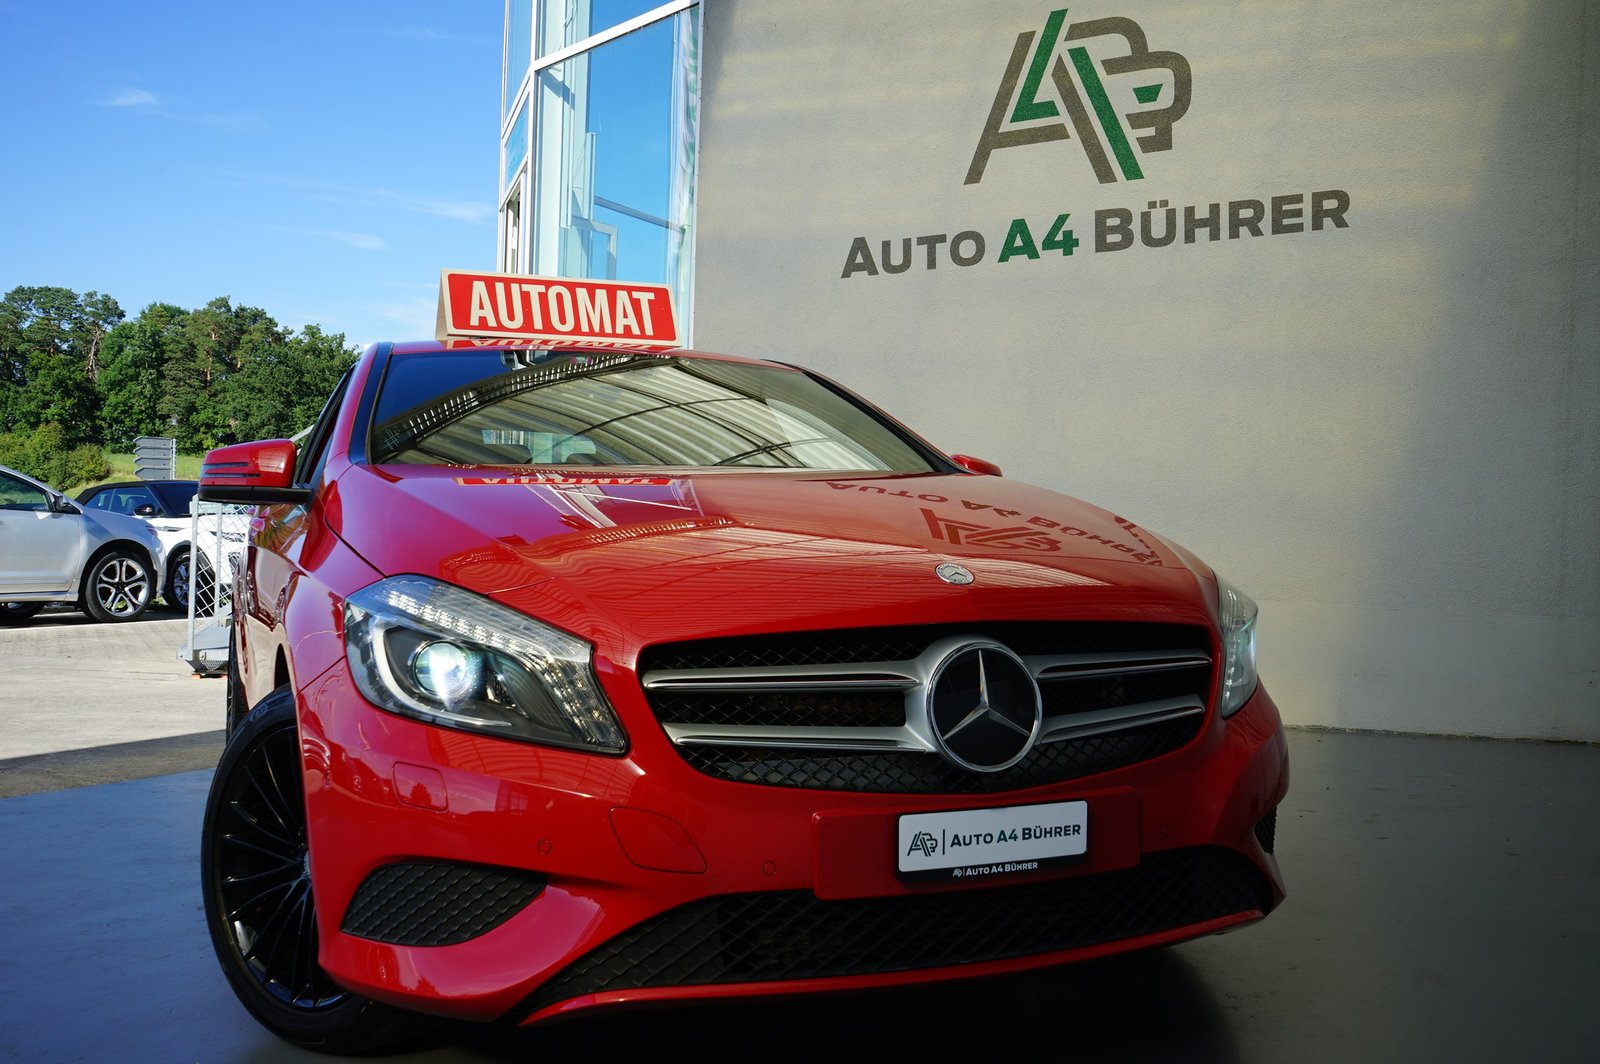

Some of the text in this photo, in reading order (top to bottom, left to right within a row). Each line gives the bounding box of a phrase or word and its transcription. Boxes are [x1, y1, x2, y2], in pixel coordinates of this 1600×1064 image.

[840, 189, 1350, 278] AUTO A4 BÜHRER
[469, 280, 655, 336] AUTOMAT
[950, 833, 994, 848] AUTO
[997, 828, 1019, 843] A4
[1022, 824, 1081, 841] BÜHRER
[966, 867, 990, 877] AUTO
[991, 865, 1003, 873] A4
[1004, 862, 1038, 872] BÜHRER
